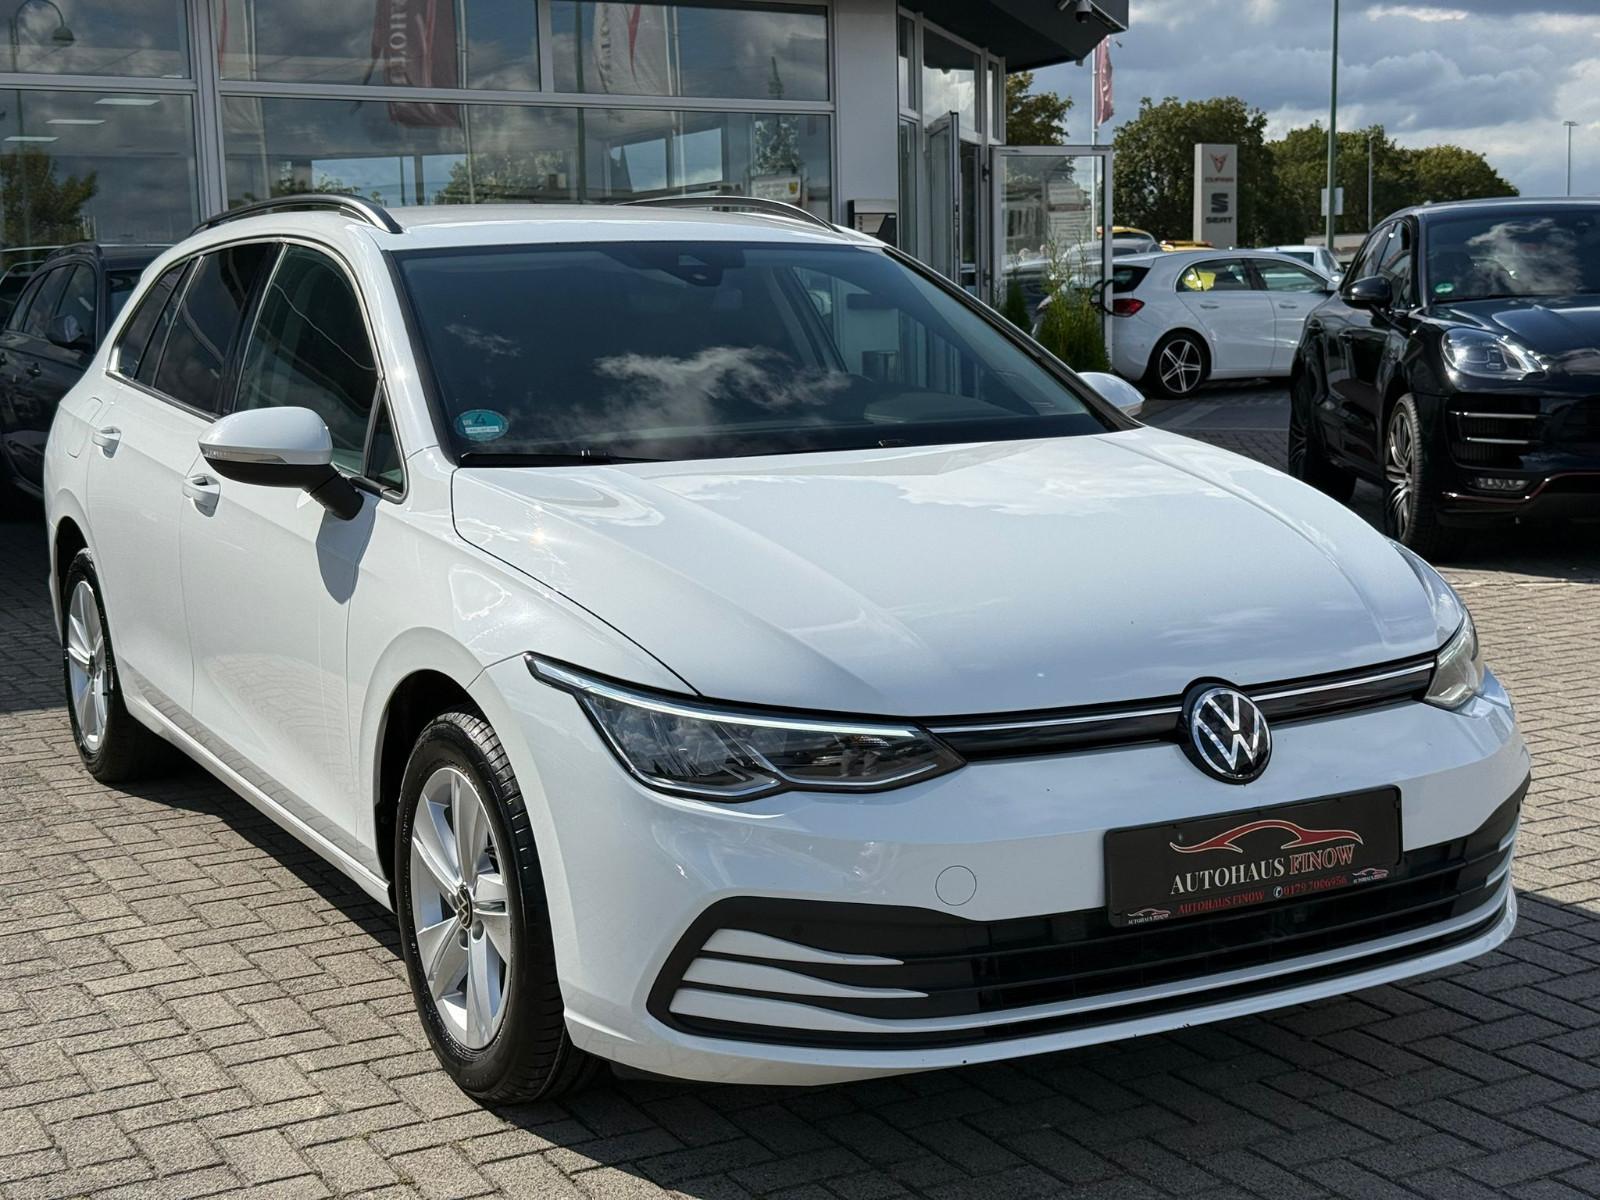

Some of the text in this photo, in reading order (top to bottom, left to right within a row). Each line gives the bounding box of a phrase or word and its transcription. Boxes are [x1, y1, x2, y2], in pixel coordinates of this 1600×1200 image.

[1170, 843, 1356, 895] AUTOHAUS FINOW
[1178, 891, 1264, 914] AUTOHAUS FINOW
